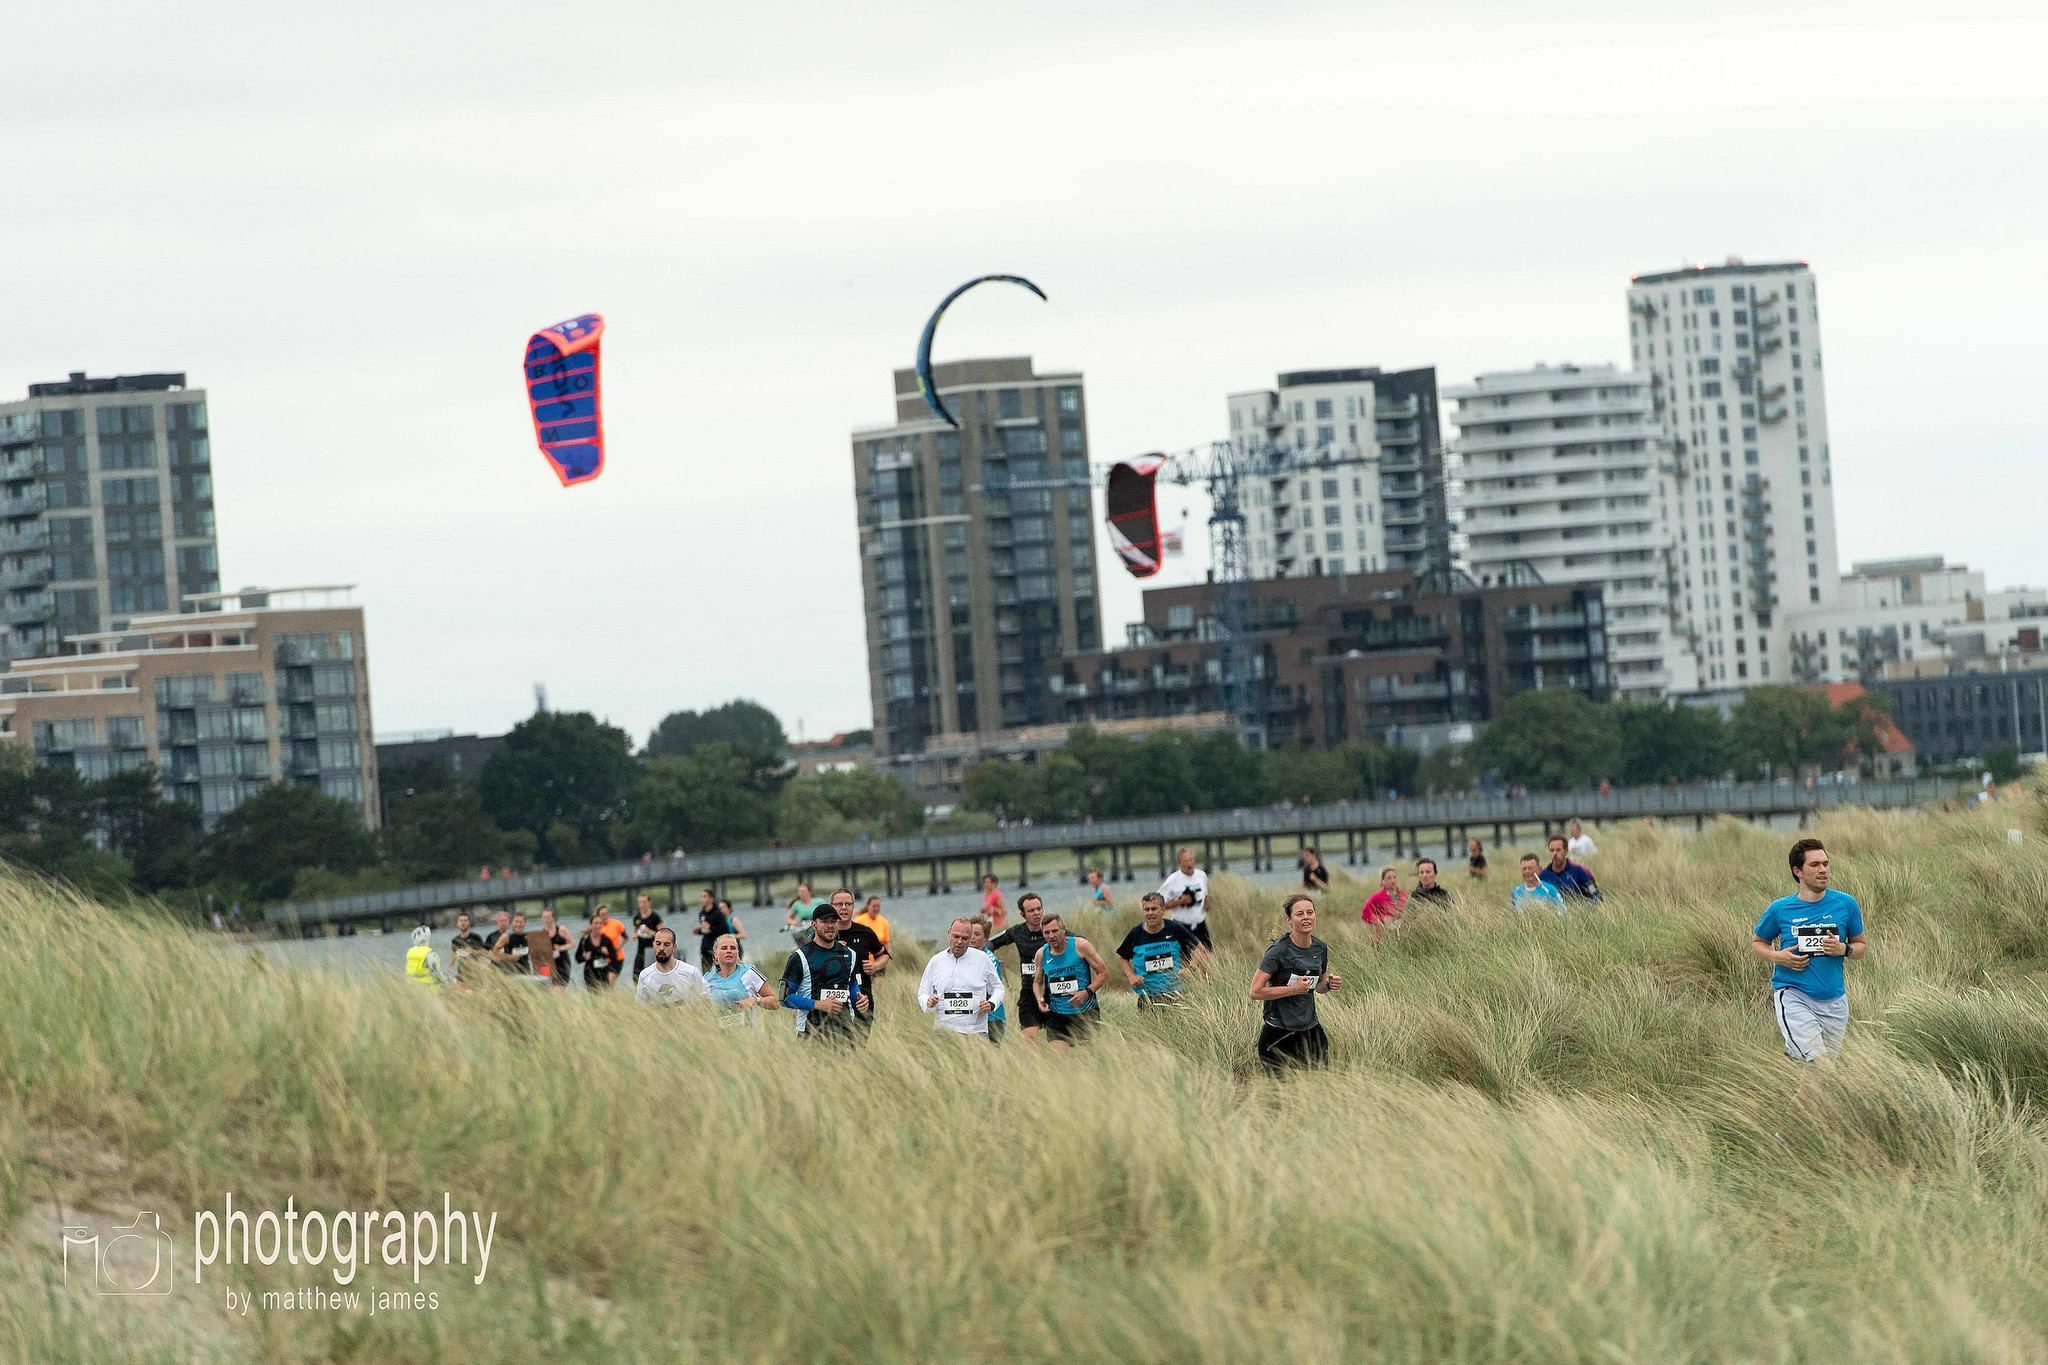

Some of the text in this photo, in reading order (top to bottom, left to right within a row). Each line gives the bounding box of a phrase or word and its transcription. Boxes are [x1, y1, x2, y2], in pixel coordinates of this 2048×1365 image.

[1144, 944, 1170, 952] SPARTA
[1152, 959, 1166, 968] 217
[1048, 965, 1076, 976] SPARTA
[1056, 982, 1071, 990] 250
[826, 991, 845, 999] 2332
[949, 999, 969, 1008] 1828
